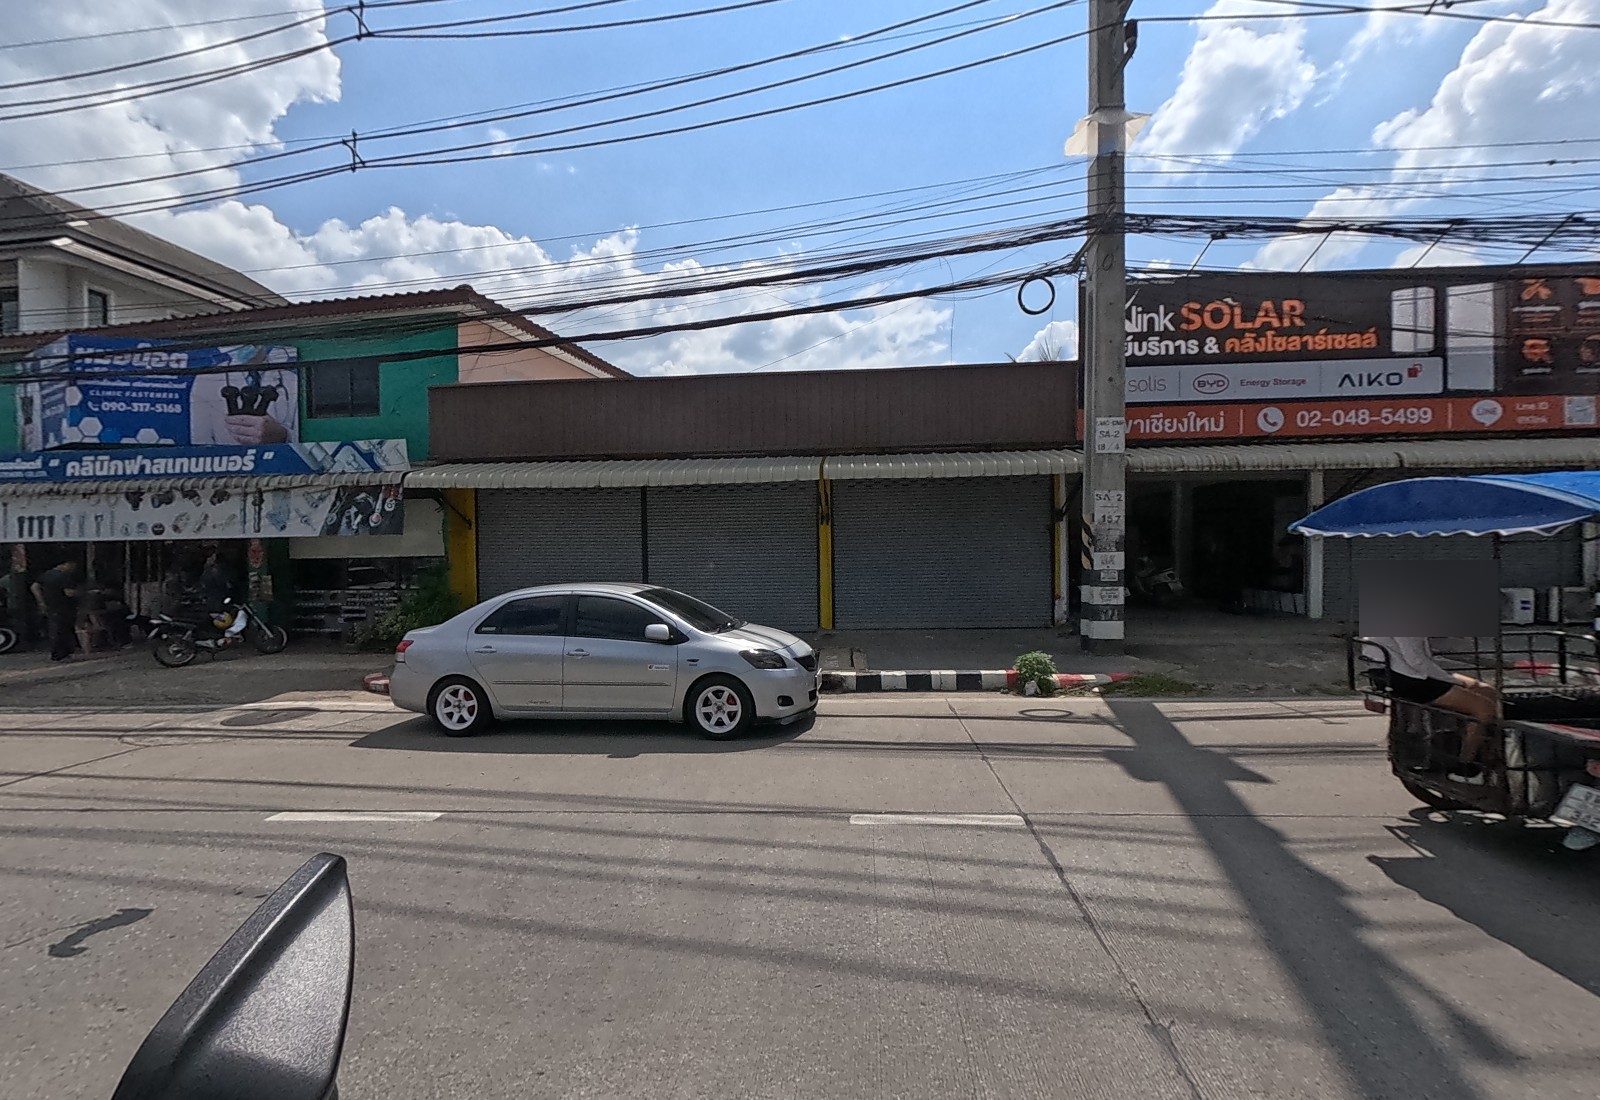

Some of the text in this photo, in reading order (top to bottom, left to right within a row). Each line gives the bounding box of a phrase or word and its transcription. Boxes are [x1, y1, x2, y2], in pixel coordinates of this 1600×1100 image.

[1181, 300, 1306, 331] SOLAR
[1203, 337, 1221, 355] &
[1128, 375, 1167, 392] solis
[1197, 380, 1226, 388] BYD
[1240, 377, 1307, 388] Energy Storage
[1338, 371, 1404, 389] AIKO
[89, 389, 180, 399] CLINIC FASTENERS
[101, 401, 183, 414] 090-317-5168
[1296, 407, 1433, 428] 02-048-5499
[1099, 430, 1121, 439] SA-2
[66, 448, 257, 477] คลินิกฟาสเทนเนอร์
